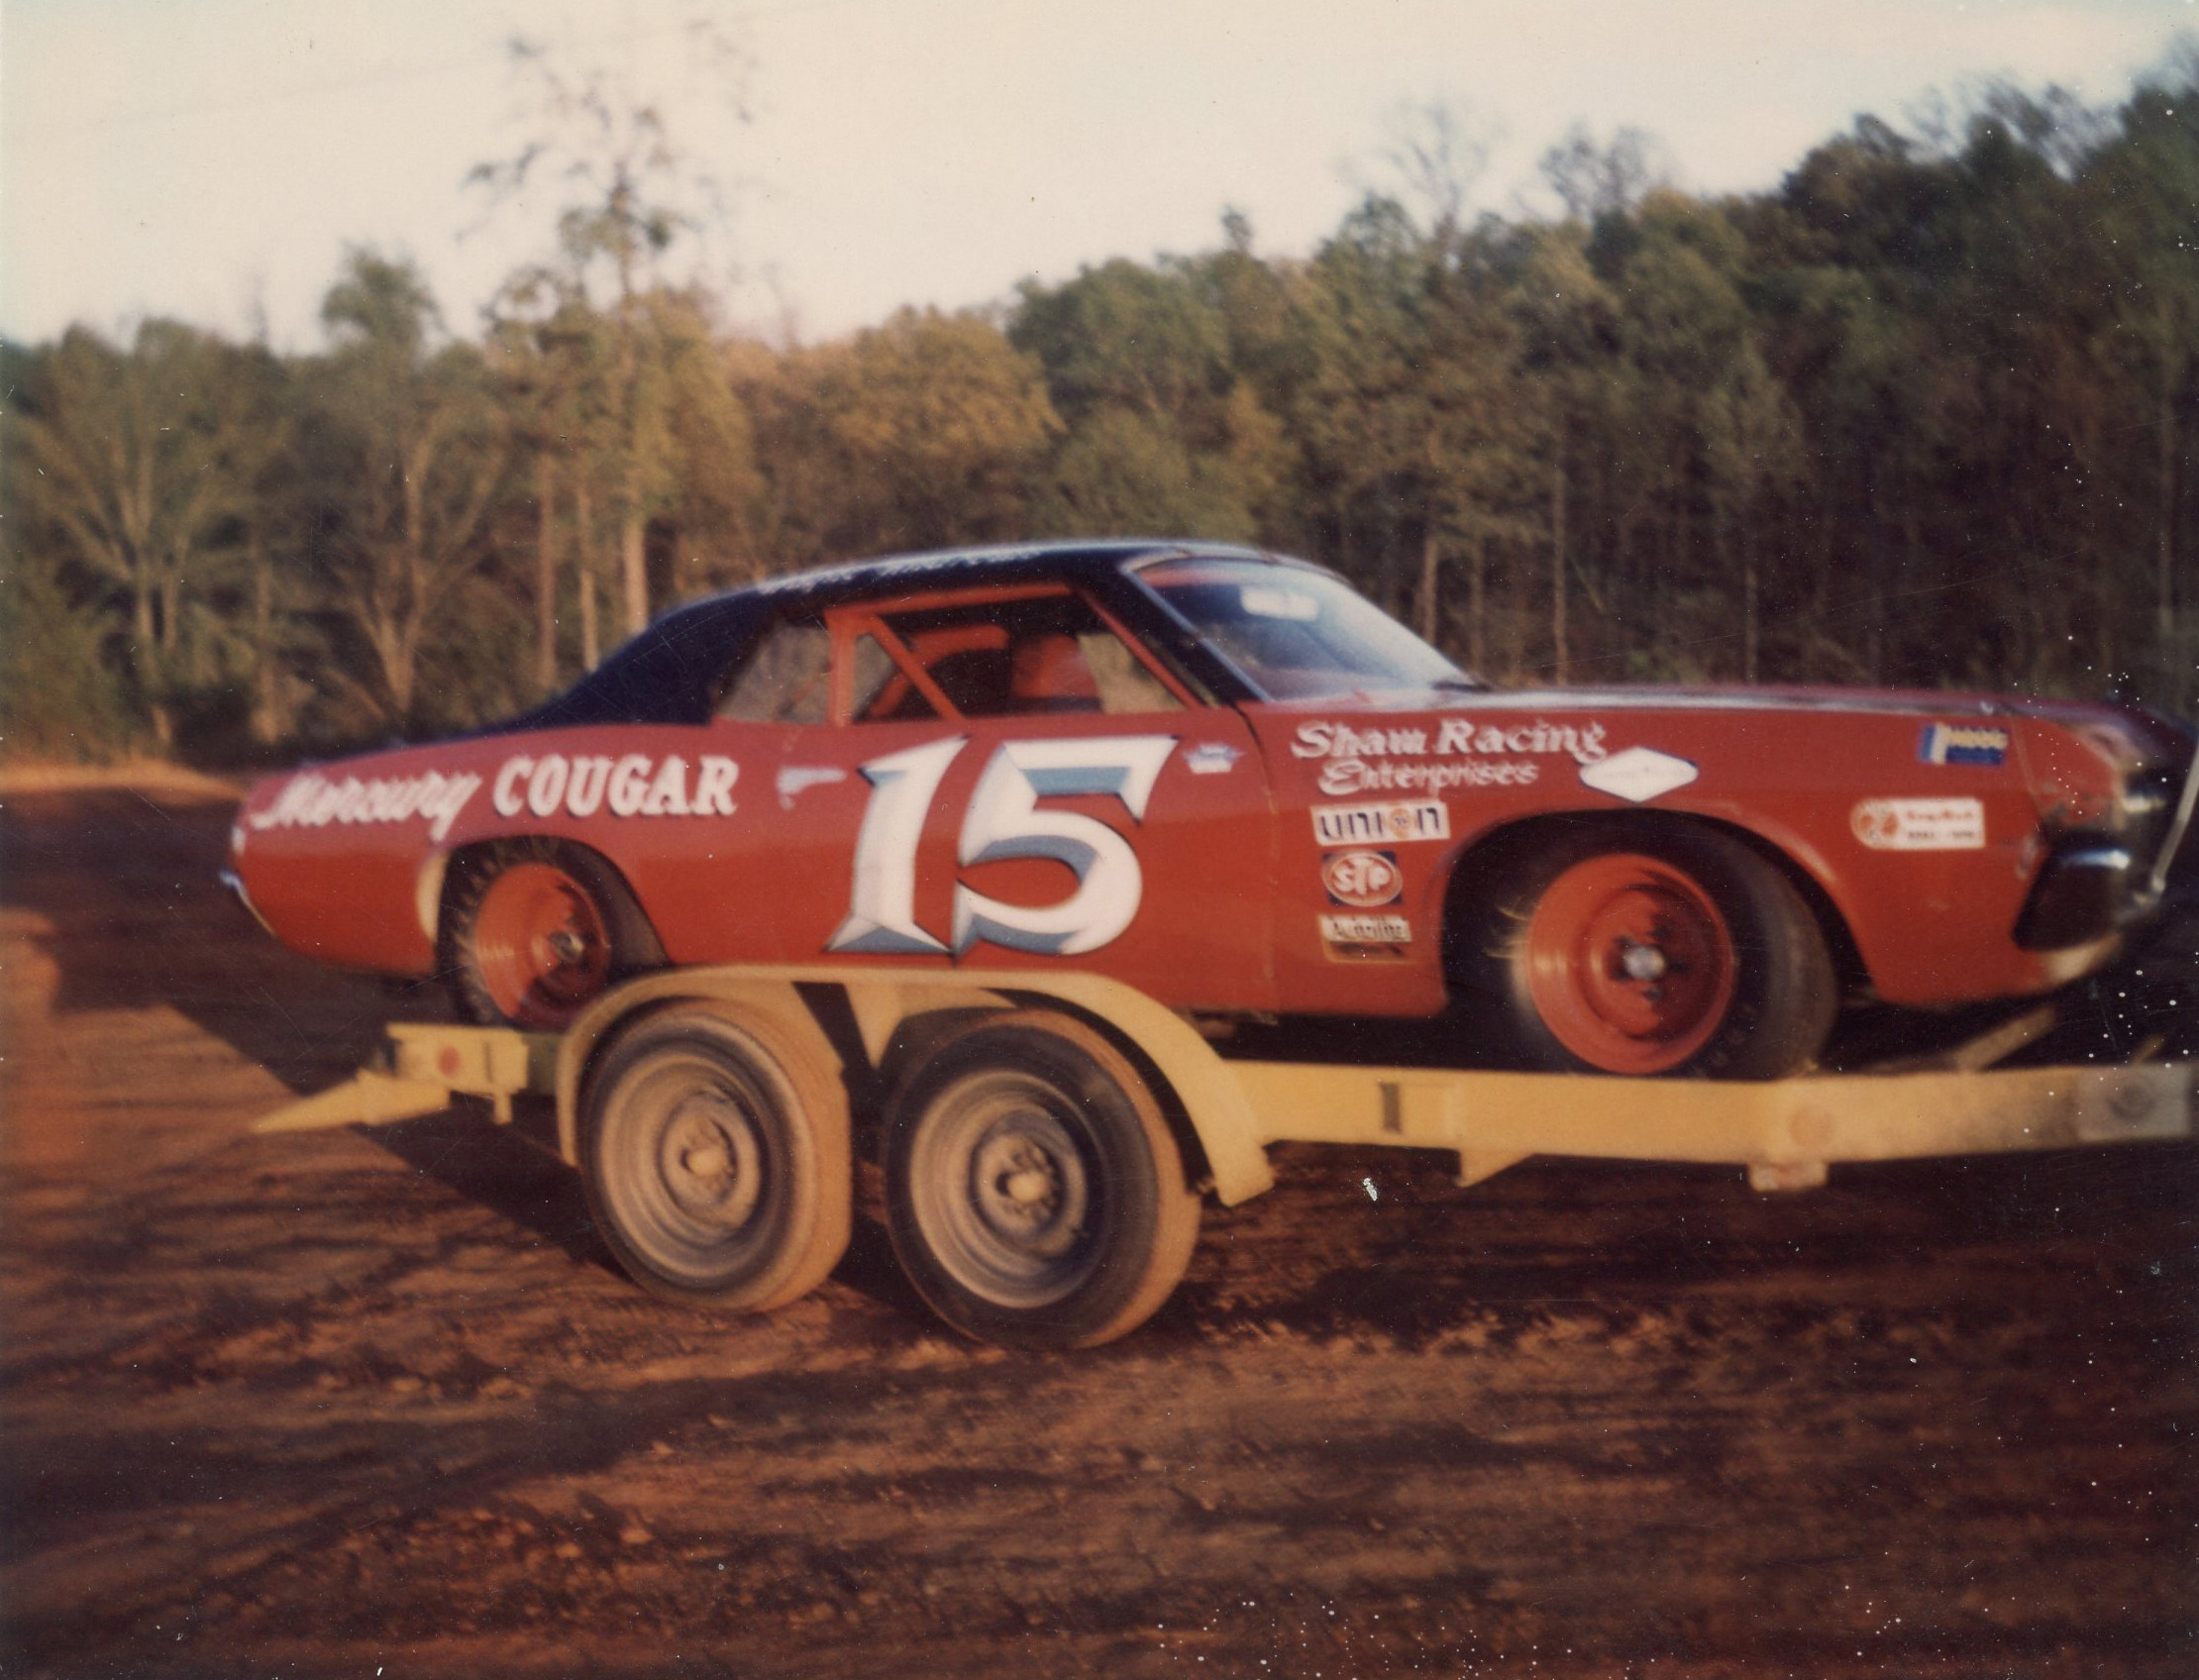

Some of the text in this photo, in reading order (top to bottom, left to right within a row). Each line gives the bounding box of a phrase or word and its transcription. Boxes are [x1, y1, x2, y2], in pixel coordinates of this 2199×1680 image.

[1291, 718, 1607, 764] Shaw Racing
[493, 754, 739, 817] COUGAR
[1317, 757, 1540, 798] Enterprises
[824, 734, 1179, 964] 15
[1330, 856, 1393, 895] STP
